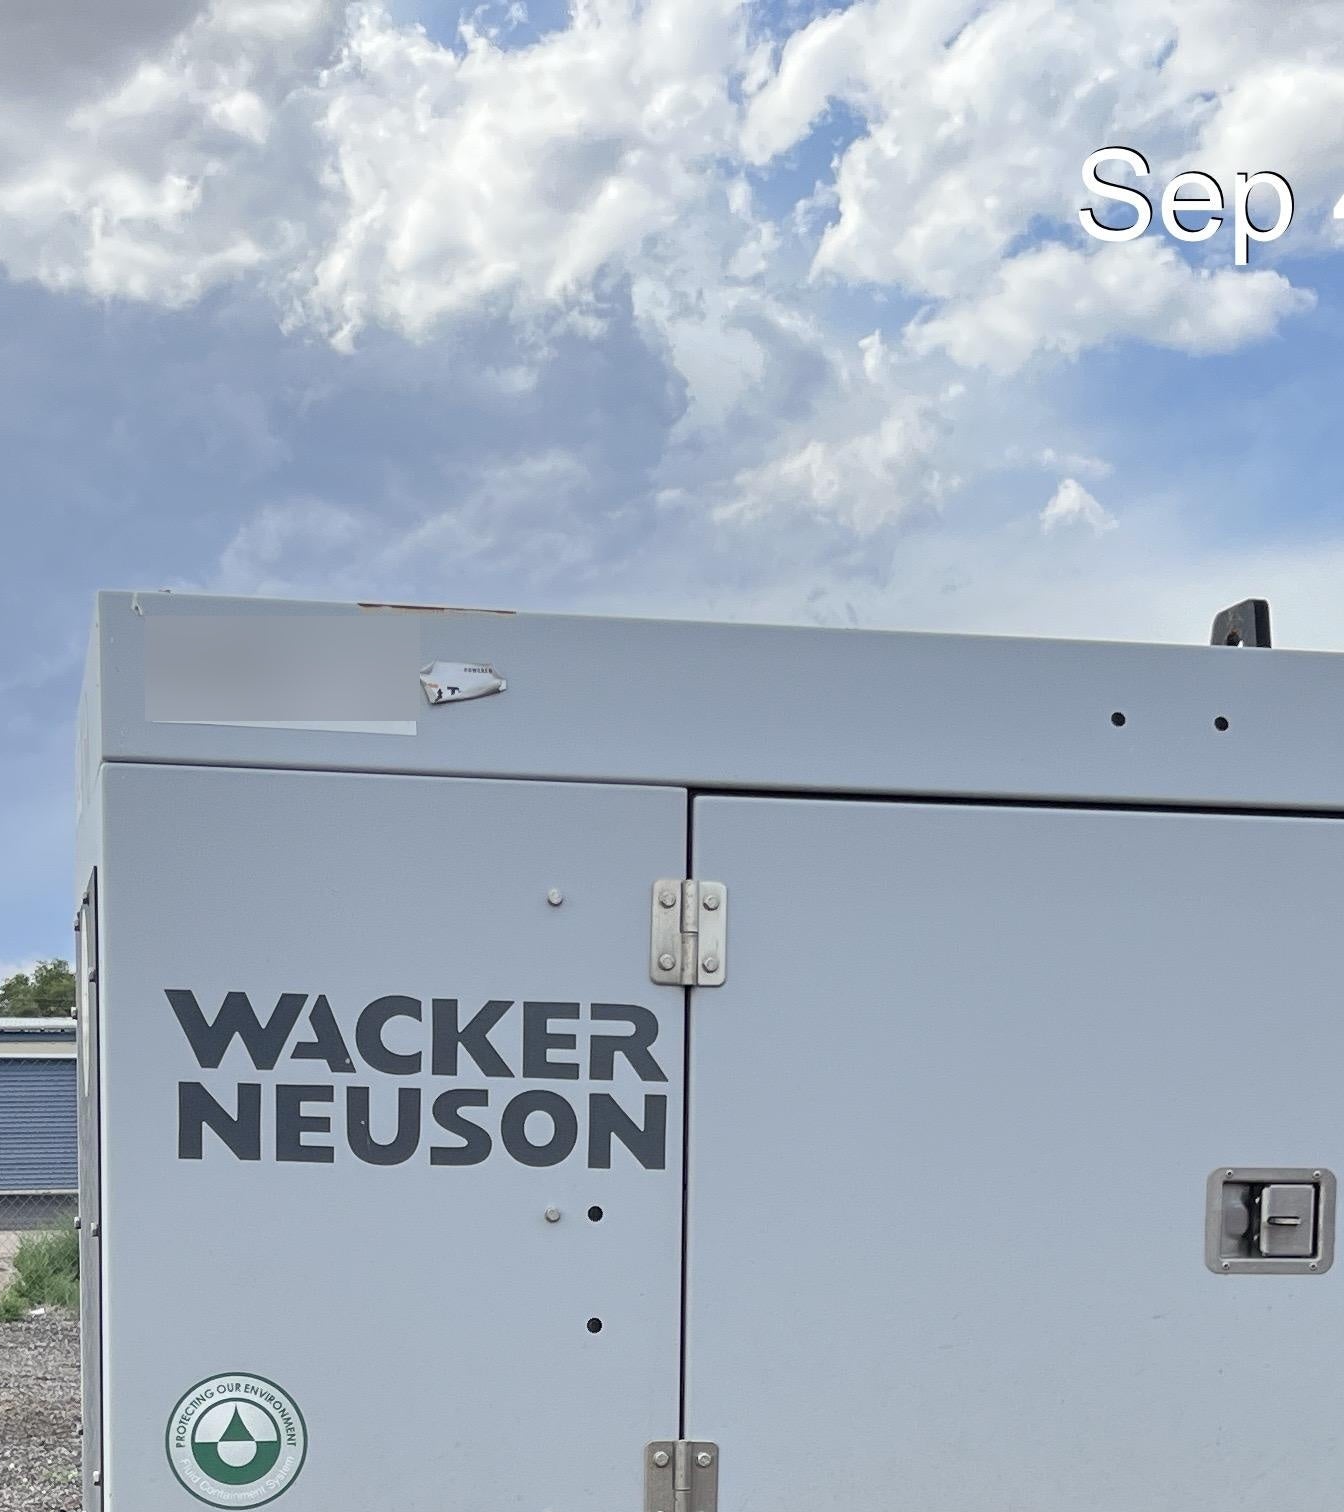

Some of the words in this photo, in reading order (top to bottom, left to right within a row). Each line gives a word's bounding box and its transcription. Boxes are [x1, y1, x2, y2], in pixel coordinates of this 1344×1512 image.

[164, 989, 669, 1082] WACKER
[177, 1081, 668, 1170] NEUSON
[176, 1388, 214, 1448] PROTECTING
[216, 1382, 241, 1394] OUR
[243, 1383, 297, 1447] ENVIRONMENT
[180, 1457, 202, 1484] Fluid
[199, 1480, 267, 1501] Containment
[265, 1455, 296, 1490] System
